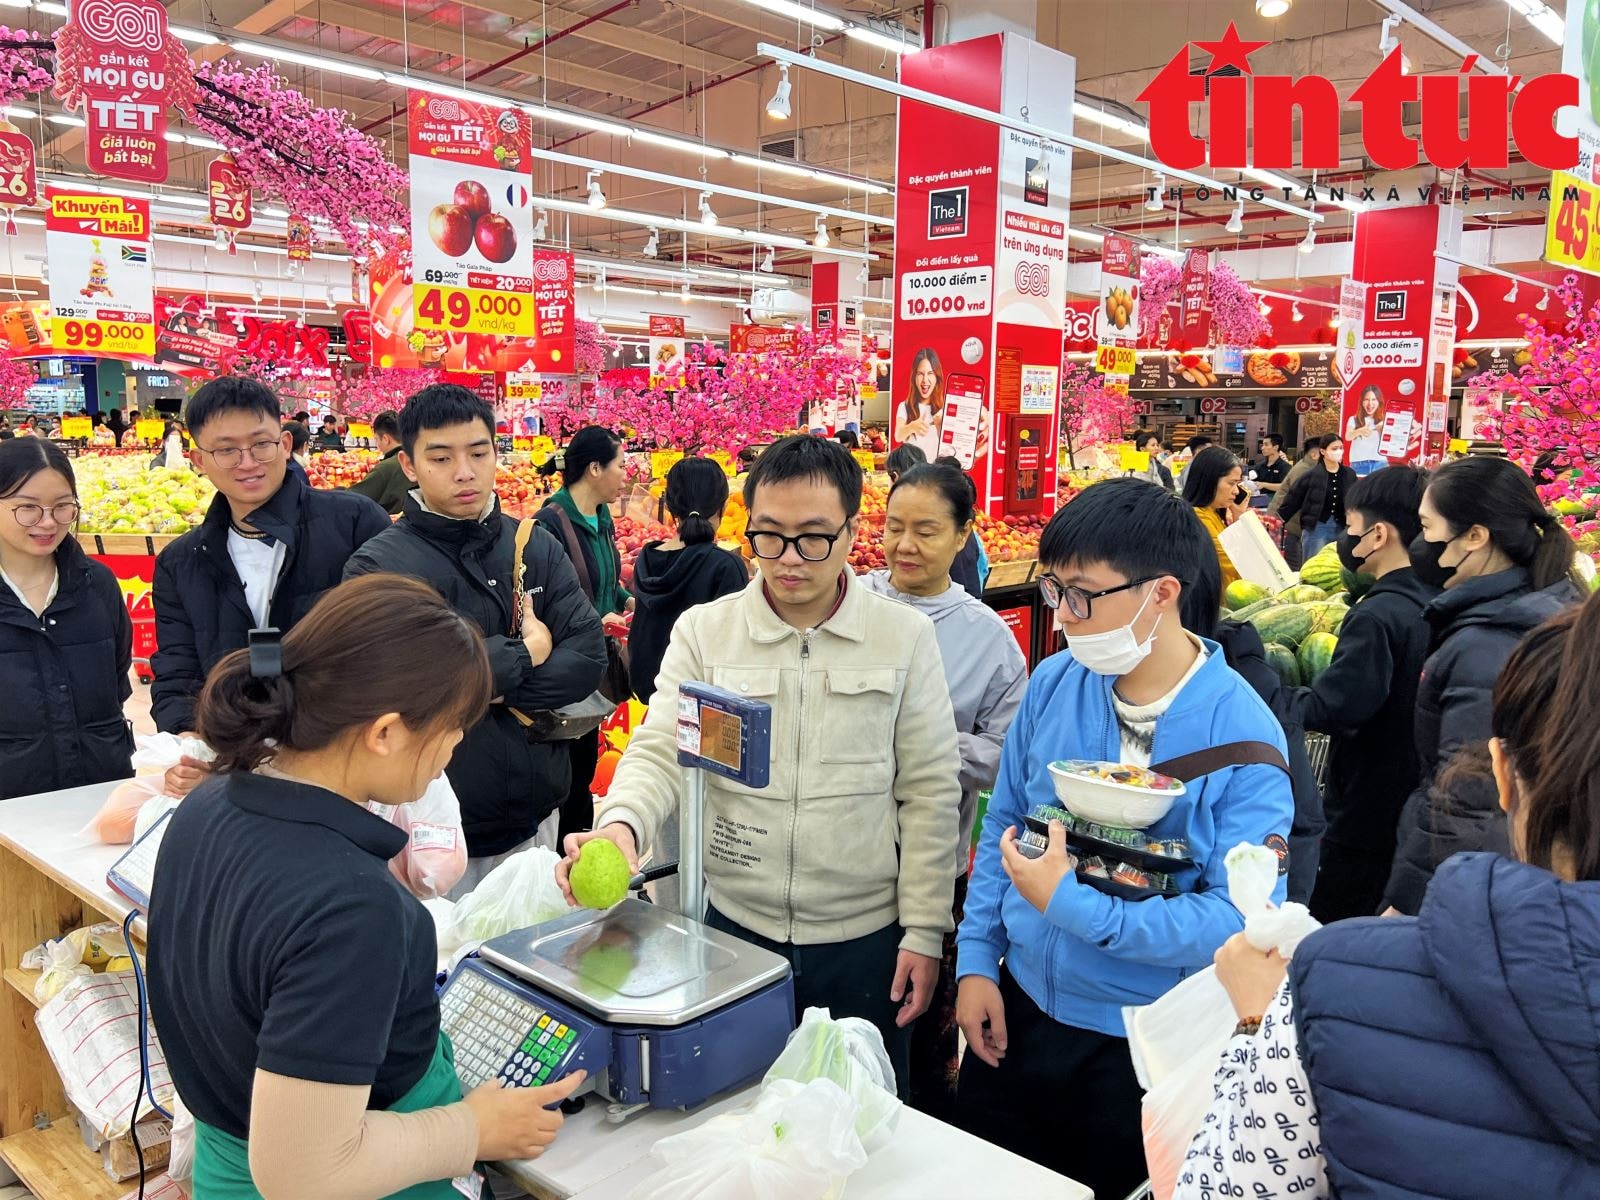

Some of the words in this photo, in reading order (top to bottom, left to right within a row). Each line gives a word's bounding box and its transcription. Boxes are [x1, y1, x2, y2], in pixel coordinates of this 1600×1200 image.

[79, 0, 163, 52] GO!
[128, 54, 149, 68] kết
[83, 66, 127, 90] MỌI
[132, 71, 165, 91] GU
[92, 91, 160, 131] TẾT
[429, 98, 460, 121] GO!
[418, 131, 438, 143] MỌI
[438, 132, 451, 143] GU
[451, 119, 484, 142] TẾT
[100, 134, 123, 150] Giá
[126, 136, 156, 152] luôn
[104, 149, 128, 164] bất
[130, 151, 153, 167] bại
[908, 176, 923, 186] Đặc
[925, 171, 949, 183] quyền
[950, 167, 973, 179] thành
[975, 165, 993, 176] viên
[55, 199, 121, 216] Khuyến
[215, 200, 246, 222] 26
[105, 214, 140, 234] Mãi!
[934, 224, 962, 235] Vietnam
[1006, 215, 1028, 229] Nhiều
[1003, 236, 1021, 251] trên
[1024, 240, 1040, 257] ứng
[1043, 244, 1063, 261] dụng
[534, 259, 568, 280] GO!
[1015, 261, 1050, 297] GO!
[909, 275, 947, 289] 10.000
[949, 271, 977, 287] điểm
[535, 290, 552, 302] MỌI
[554, 289, 568, 299] GU
[907, 295, 965, 315] 10.000
[967, 300, 986, 312] vnd
[418, 288, 522, 328] 49.000
[538, 301, 566, 319] TẾT
[479, 317, 516, 331] vnd/kg
[65, 321, 144, 348] 99.000
[1362, 342, 1388, 351] 0.000
[1362, 355, 1402, 367] 0.000
[1404, 358, 1418, 366] vnd
[1200, 397, 1226, 415] 02
[1296, 397, 1323, 415] 03
[1267, 1041, 1290, 1060] alo
[1254, 1075, 1278, 1095] alo
[1286, 1077, 1306, 1107] alo
[1244, 1109, 1266, 1130] alo
[1275, 1112, 1299, 1141] alo
[1232, 1143, 1256, 1164] alo
[1264, 1147, 1288, 1176] alo
[1219, 1176, 1244, 1198] alo
[1287, 1175, 1316, 1193] alo
